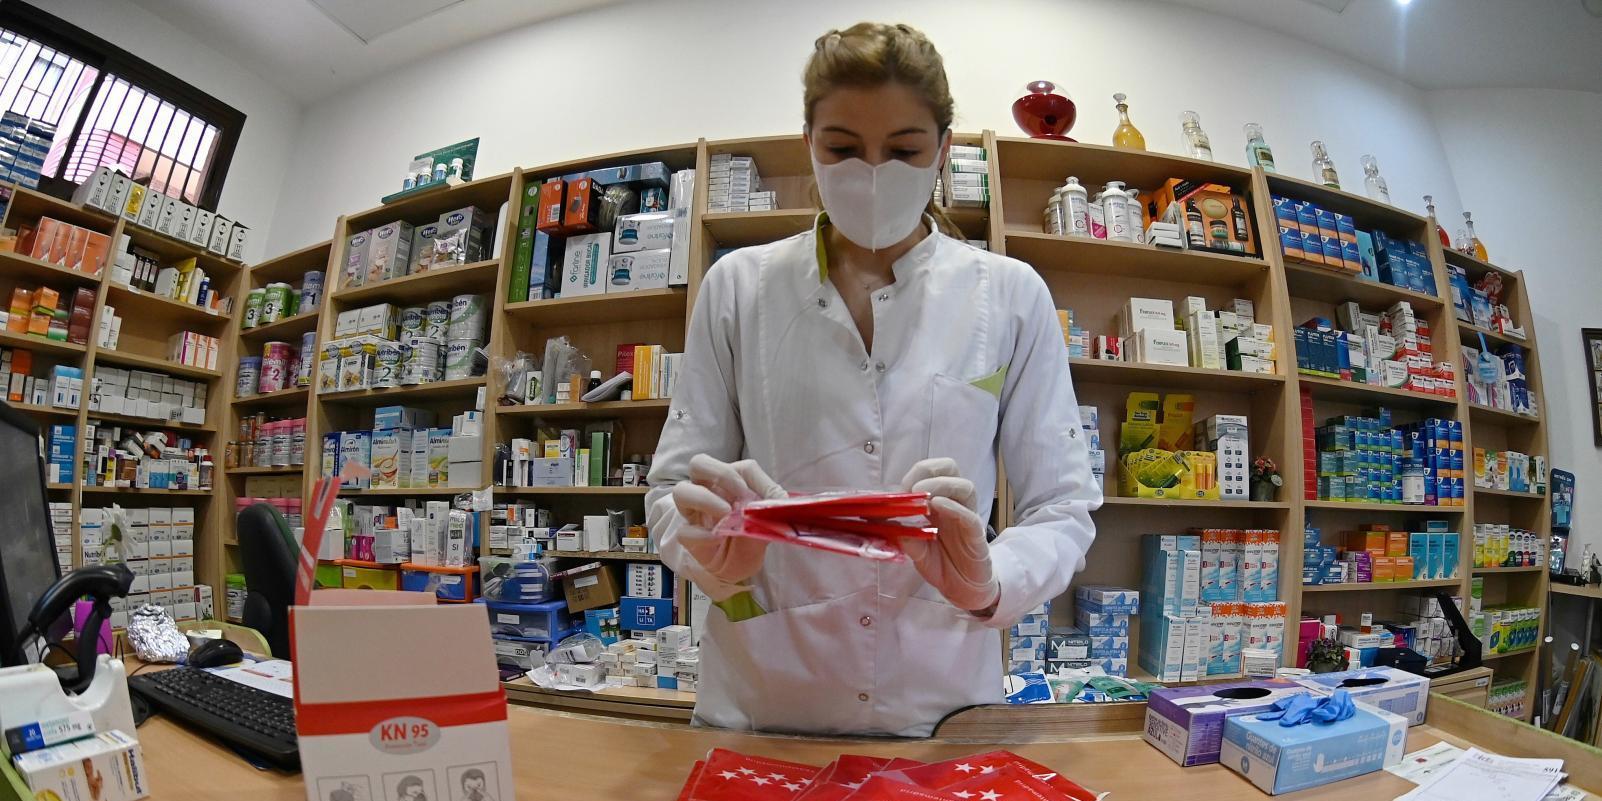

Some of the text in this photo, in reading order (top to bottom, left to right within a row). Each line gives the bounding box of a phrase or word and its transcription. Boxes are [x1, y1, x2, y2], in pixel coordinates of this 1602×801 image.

[248, 309, 255, 320] 3
[266, 303, 273, 314] 3
[431, 325, 439, 339] 2
[272, 369, 280, 381] 2
[380, 367, 391, 382] 2
[381, 723, 429, 741] KN 95
